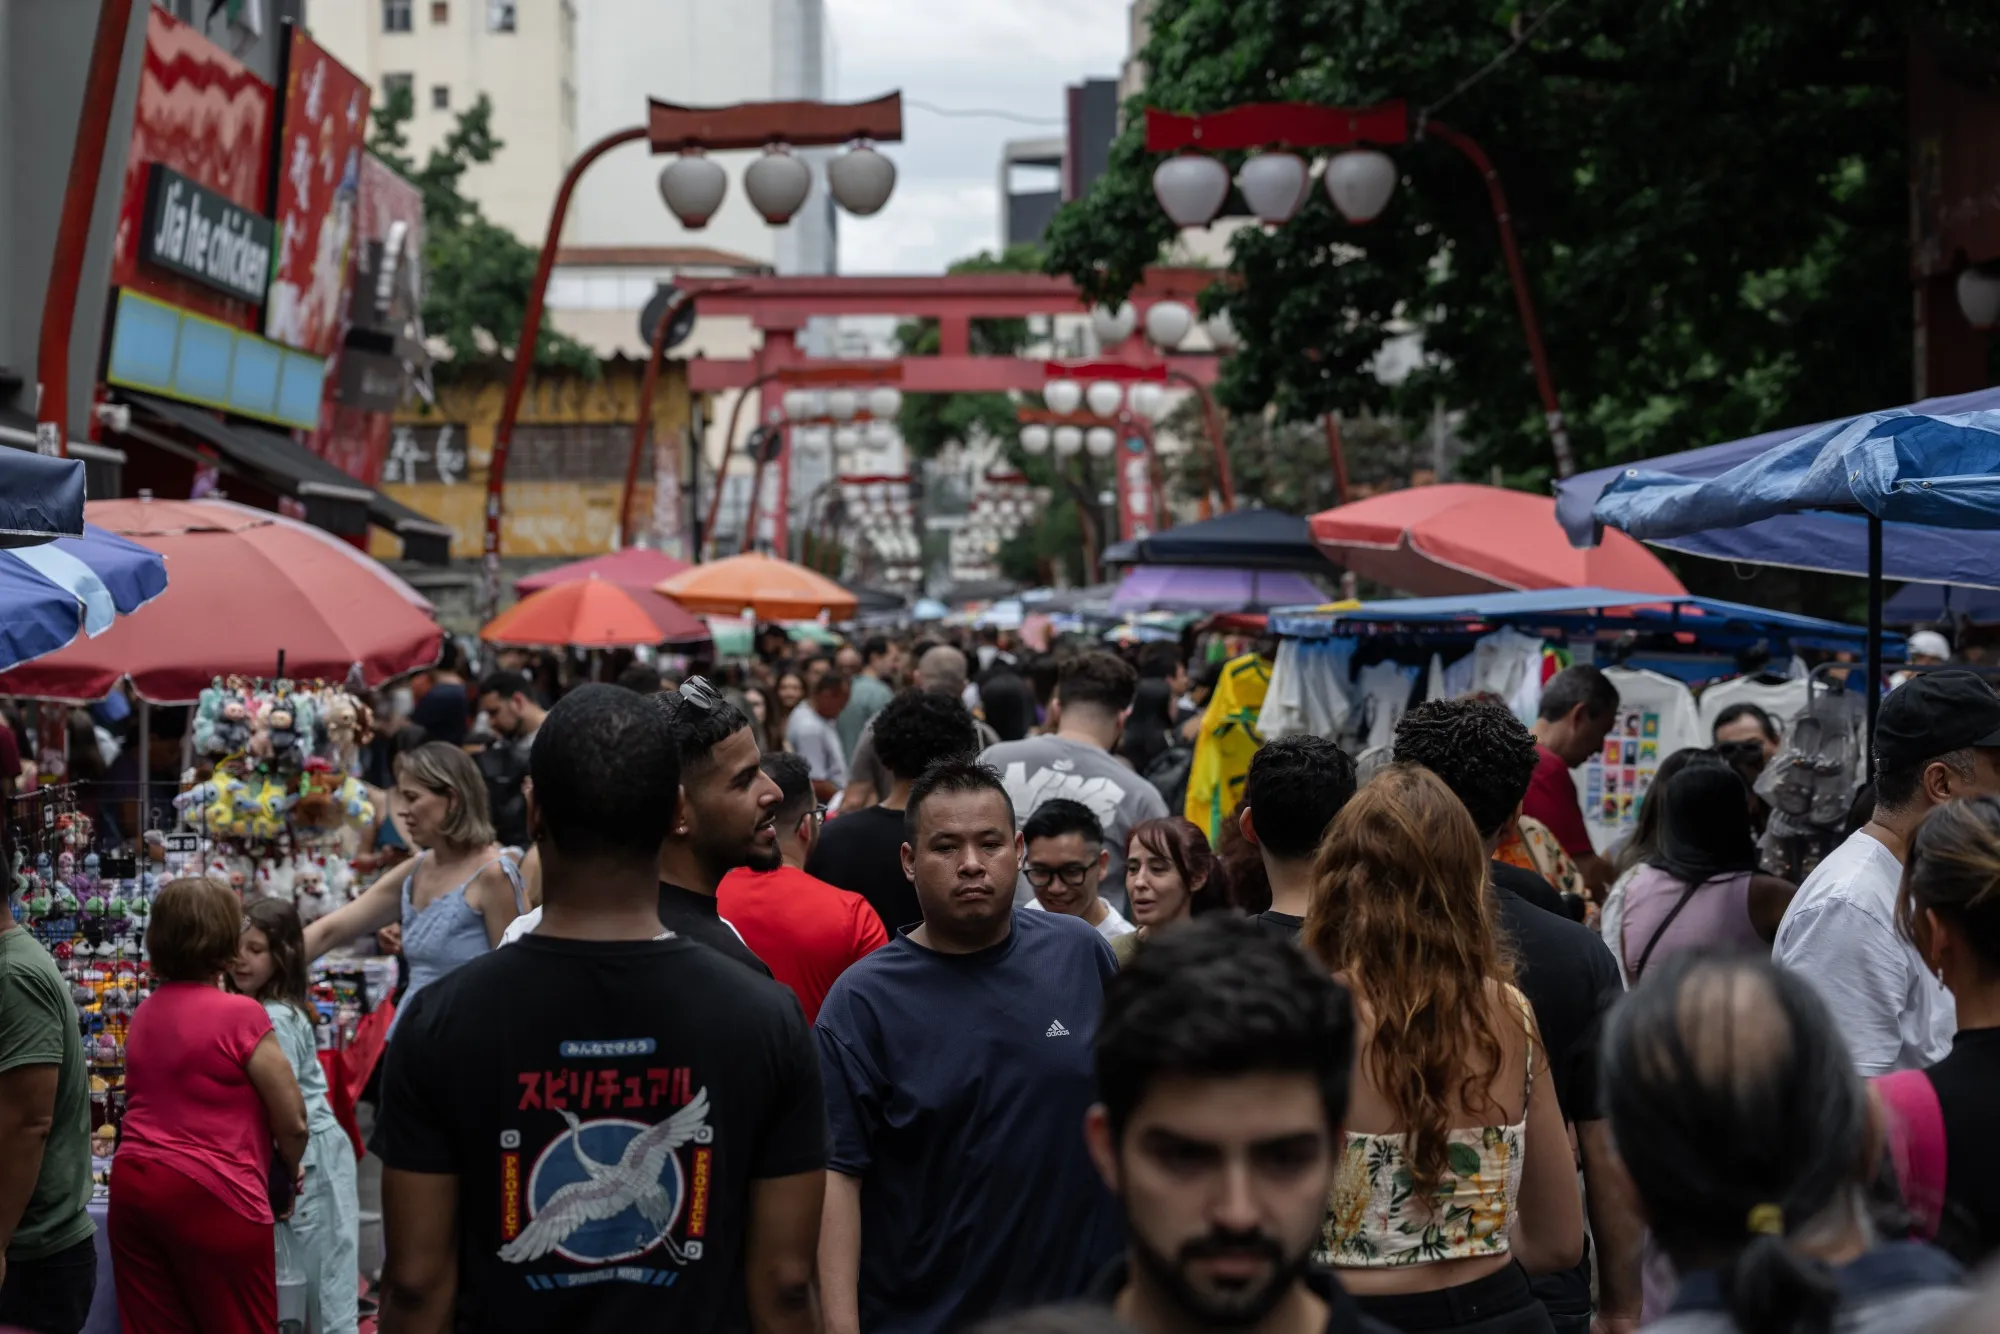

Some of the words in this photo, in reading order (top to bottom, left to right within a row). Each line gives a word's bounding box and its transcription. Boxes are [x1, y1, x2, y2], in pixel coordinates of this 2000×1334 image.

[153, 179, 188, 262] Jia
[182, 192, 211, 273] he
[206, 207, 271, 298] chicken
[1045, 1029, 1070, 1038] adidas
[517, 1066, 696, 1111] スピリチュアル
[504, 1155, 518, 1237] PROTECT
[690, 1150, 709, 1234] PROTECT
